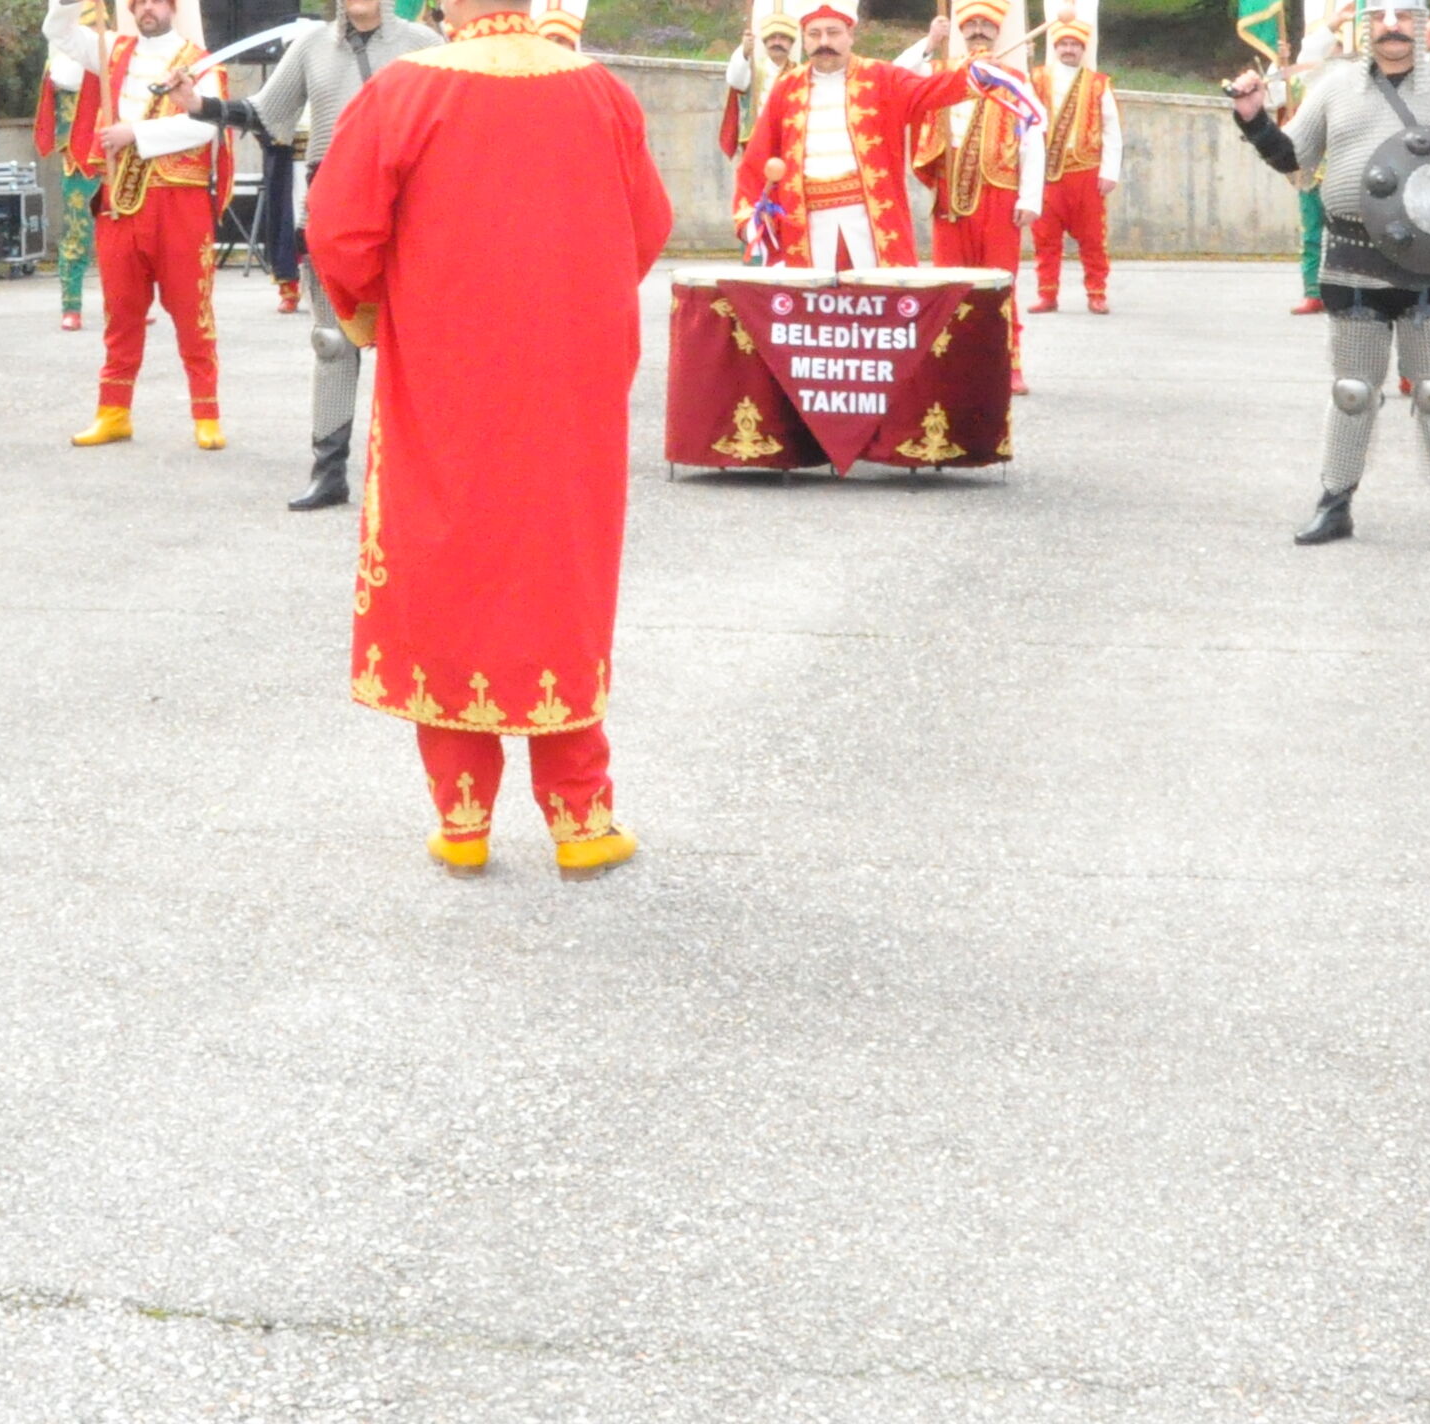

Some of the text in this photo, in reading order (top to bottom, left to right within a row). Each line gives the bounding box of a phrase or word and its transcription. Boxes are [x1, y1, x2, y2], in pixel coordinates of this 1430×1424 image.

[802, 292, 887, 316] TOKAT
[770, 322, 917, 350] BELEDİYESİ
[790, 356, 894, 382] MEHTER
[798, 389, 887, 415] TAKIMI
